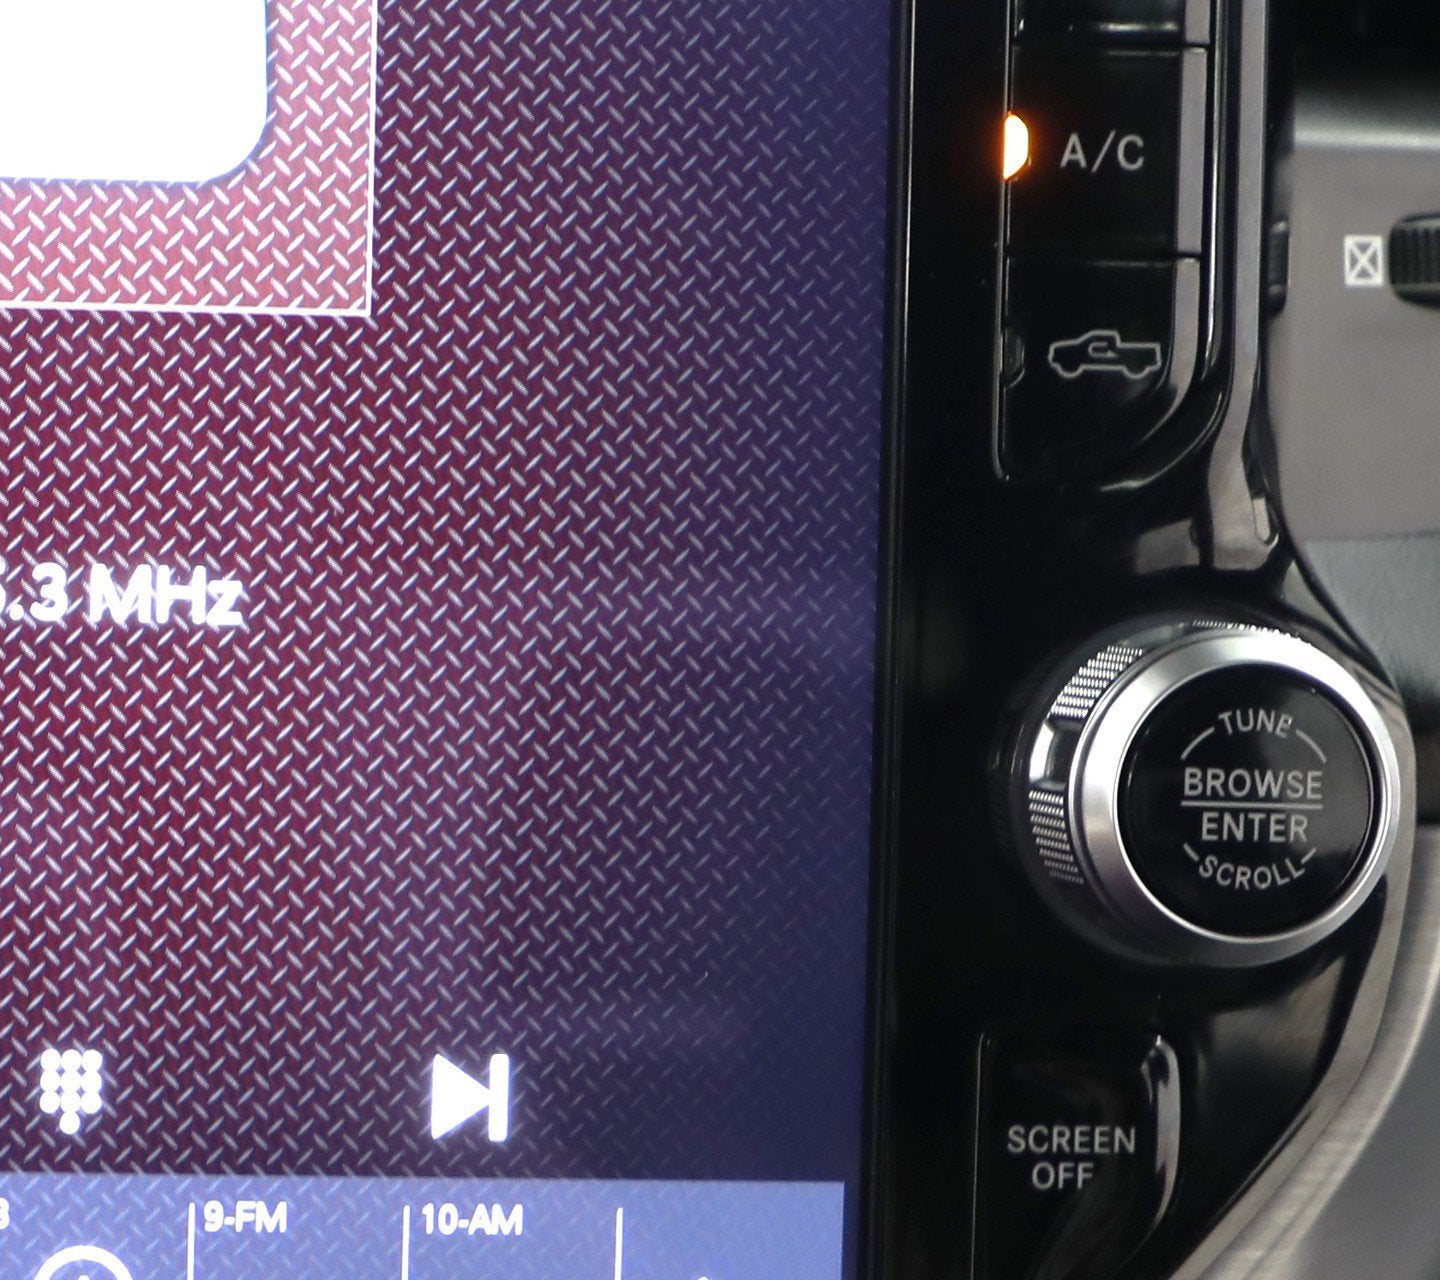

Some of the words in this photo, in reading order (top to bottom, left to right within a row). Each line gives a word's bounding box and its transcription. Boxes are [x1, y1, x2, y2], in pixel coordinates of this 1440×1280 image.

[1059, 130, 1145, 173] A/C
[90, 562, 245, 628] MHz
[1218, 707, 1295, 740] TUNE
[1183, 767, 1324, 801] BROWSE
[1201, 811, 1309, 843] ENTER
[1198, 854, 1306, 891] SCROLL
[1006, 1124, 1136, 1154] SCREEN
[1031, 1161, 1095, 1190] OFF
[203, 1201, 288, 1234] 9-FM
[421, 1202, 524, 1236] 10-AM
